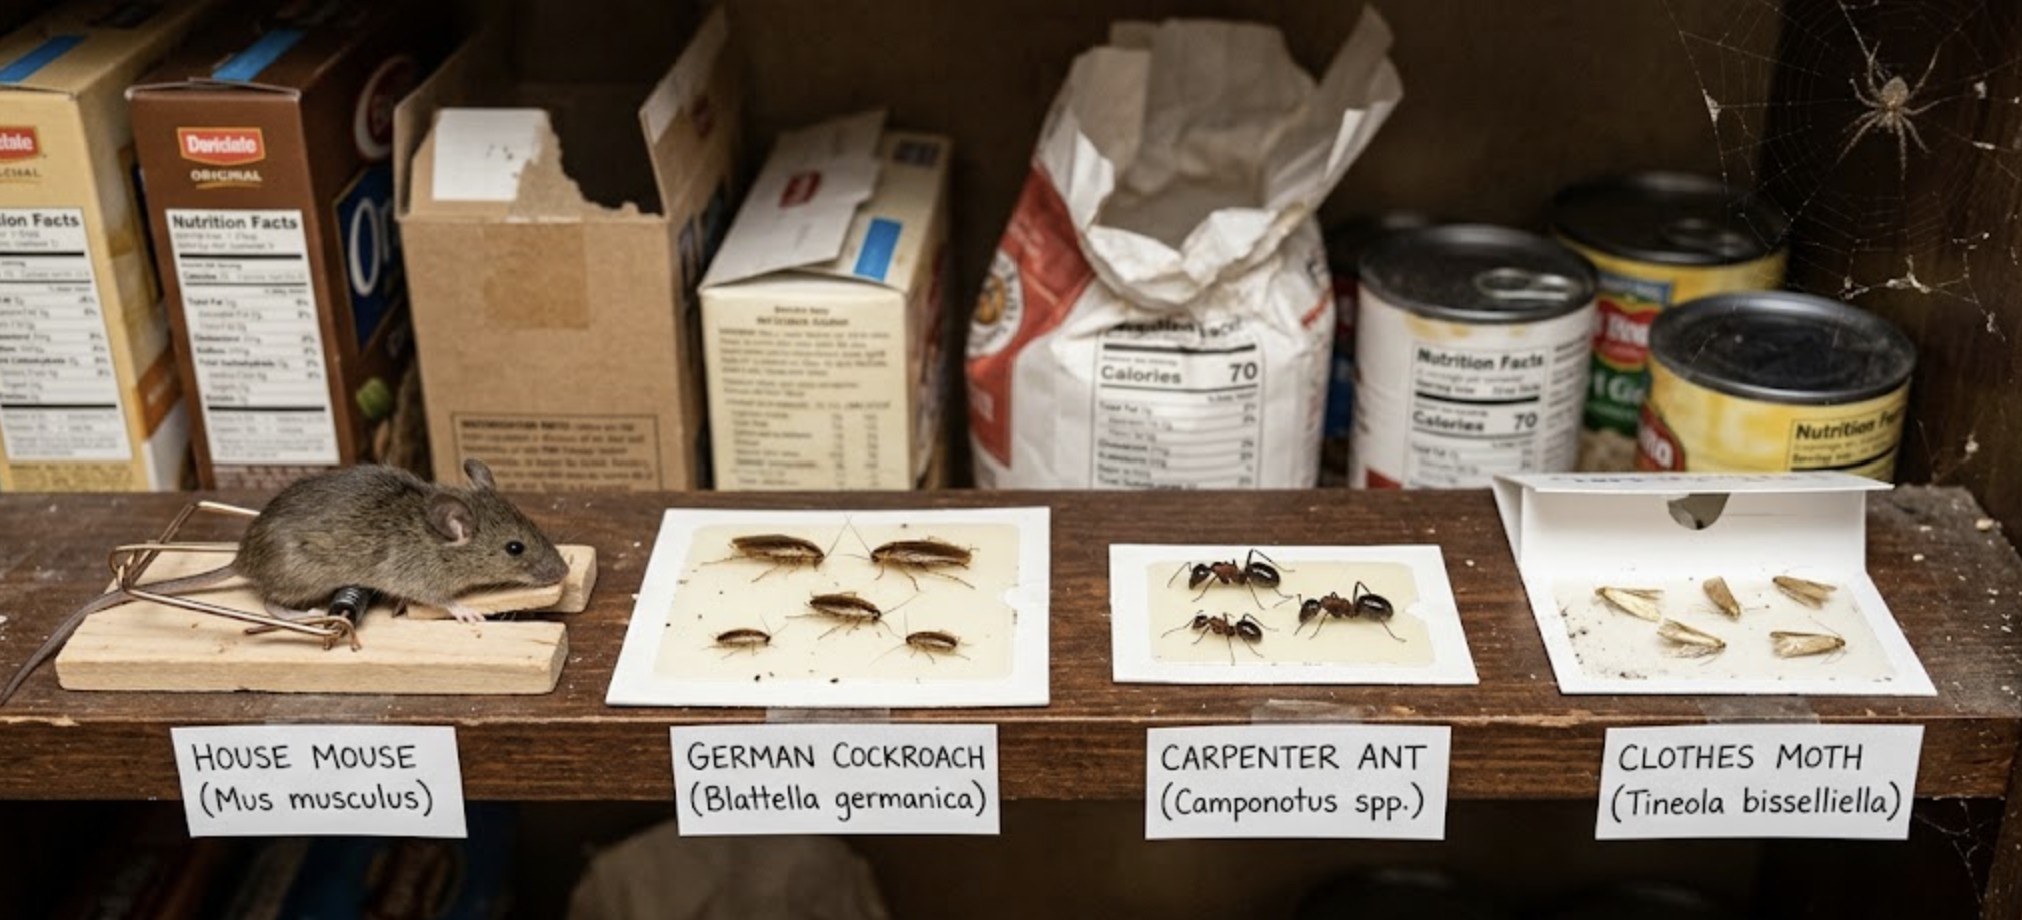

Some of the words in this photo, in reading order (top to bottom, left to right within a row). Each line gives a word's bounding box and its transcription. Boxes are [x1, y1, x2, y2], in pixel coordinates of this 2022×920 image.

[32, 213, 80, 228] Facts
[172, 215, 246, 230] Nutrition
[251, 216, 298, 230] Facts
[1417, 348, 1494, 370] Nutrition
[1501, 354, 1544, 370] Facts
[1101, 365, 1182, 384] Calories
[1229, 362, 1258, 383] 70
[1413, 410, 1484, 431] Calories
[1514, 412, 1538, 430] 70
[1796, 419, 1876, 440] Nutrition
[192, 744, 292, 771] HOUSE
[312, 744, 417, 770] MOUSE
[687, 742, 815, 770] GERMAN
[833, 742, 985, 770] COCKROACH
[1161, 744, 1339, 770] CARPENTER
[1358, 743, 1427, 770] ANT
[1618, 744, 1754, 770] CLOTHES
[1776, 744, 1863, 770] MOTH
[200, 781, 273, 818] (Mus
[289, 779, 433, 817] musculus)
[690, 781, 820, 817] (Blattella
[835, 779, 986, 822] germanica)
[1161, 782, 1338, 822] (Camponotus
[1355, 782, 1424, 821] spp.)
[1611, 784, 1724, 823] (Tineola
[1743, 781, 1900, 822] bisselliella)
